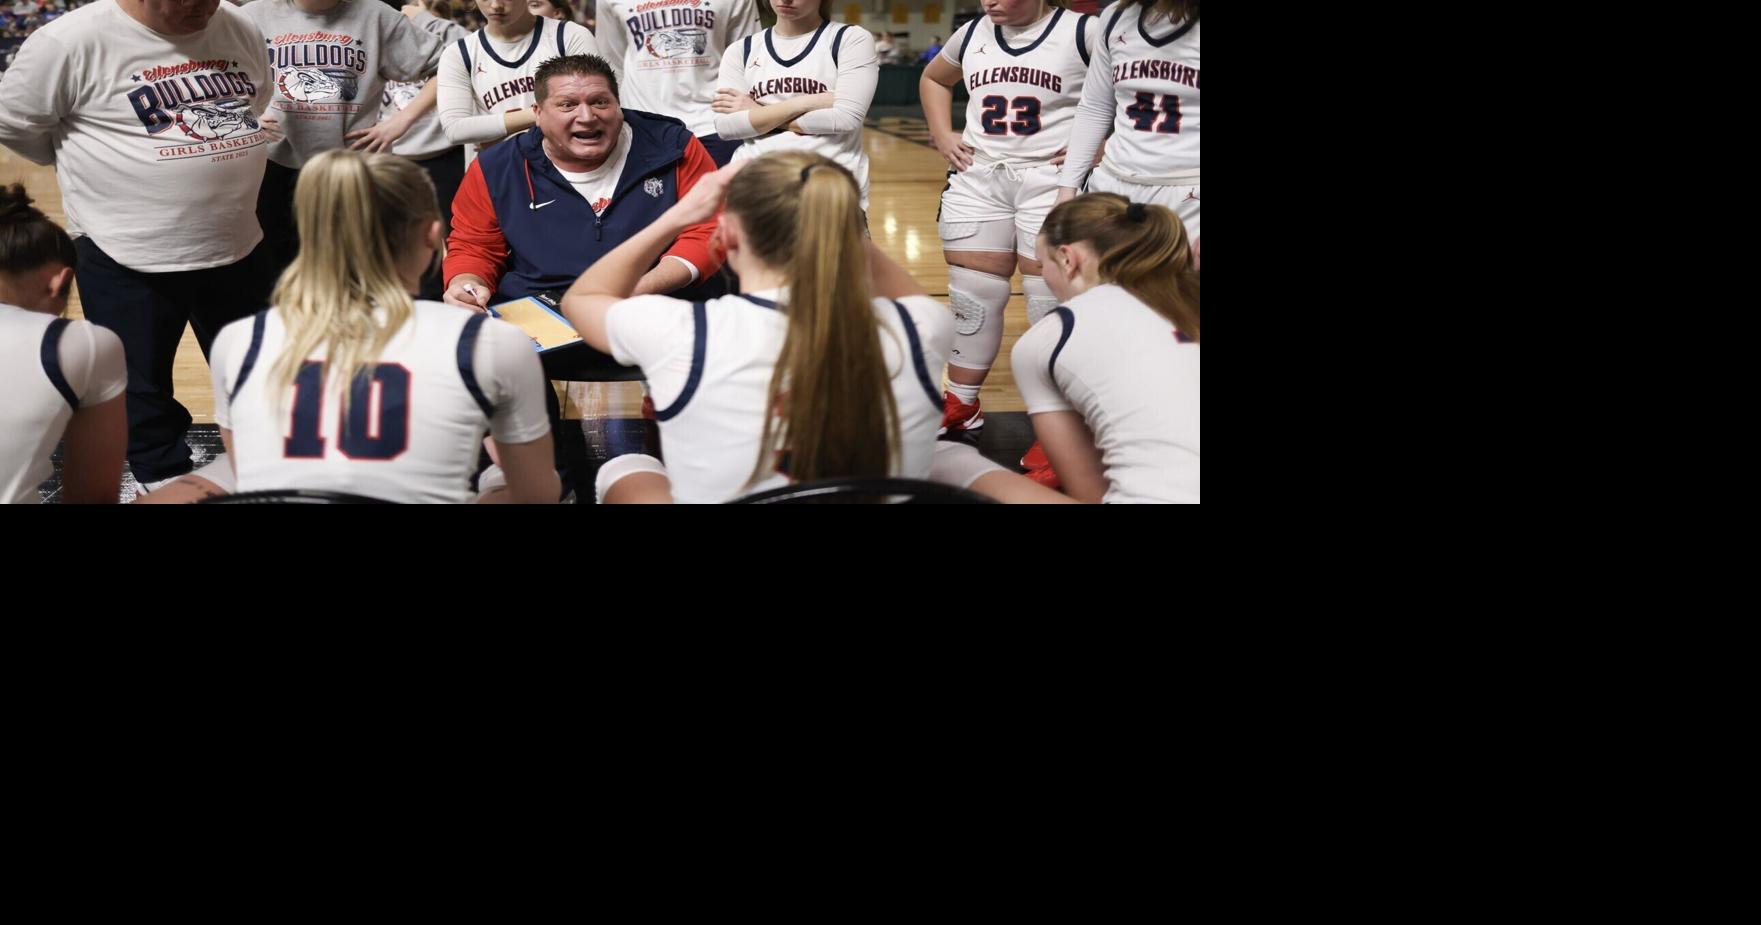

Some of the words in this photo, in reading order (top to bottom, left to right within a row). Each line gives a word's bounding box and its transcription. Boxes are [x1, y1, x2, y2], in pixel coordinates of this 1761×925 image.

[274, 31, 353, 46] Ellensburg
[626, 8, 715, 52] BULLDOGS
[142, 60, 229, 82] Ellensburg
[970, 66, 1062, 94] ELLENSBURG
[1112, 59, 1200, 90] ELLENSBUR
[127, 71, 257, 136] BULLDOGS
[483, 76, 535, 110] ELLENSB
[981, 95, 1042, 136] 23
[1125, 91, 1183, 134] 41
[159, 145, 206, 157] GIRLS
[211, 152, 234, 163] STATE
[282, 360, 412, 462] 10
